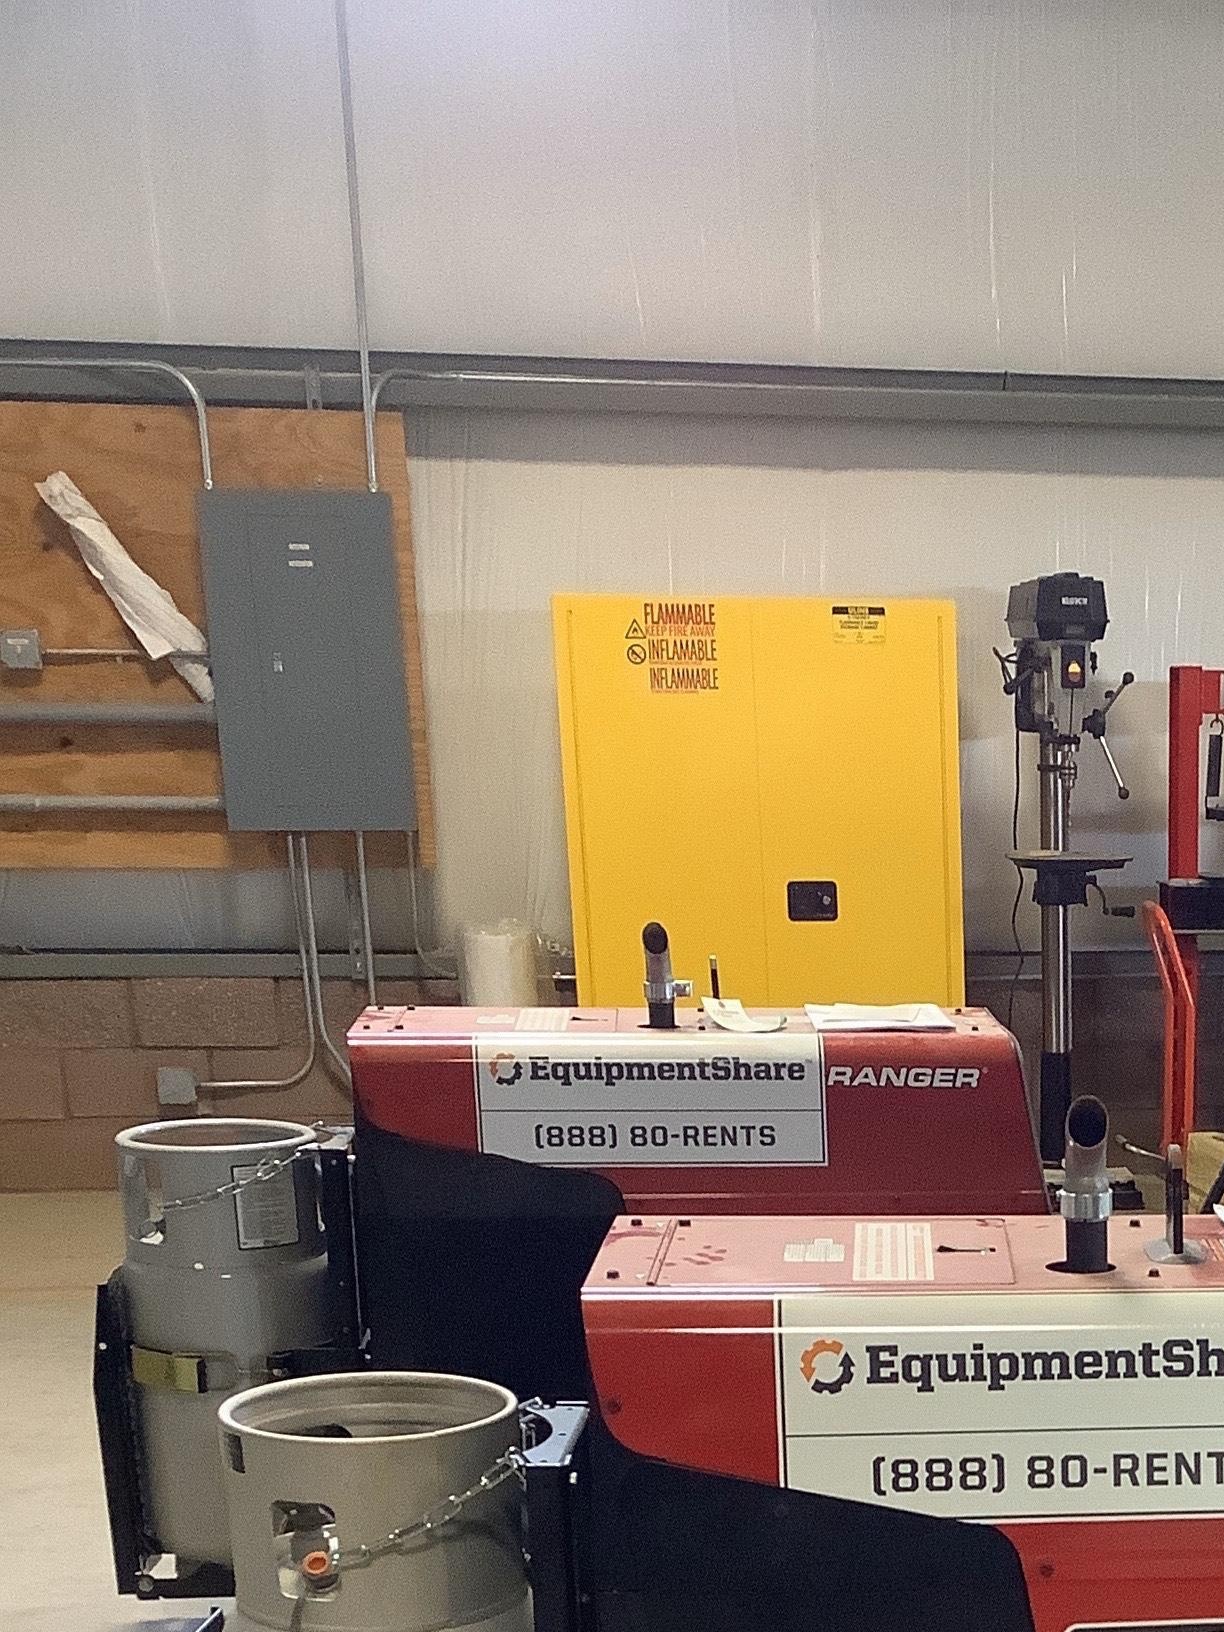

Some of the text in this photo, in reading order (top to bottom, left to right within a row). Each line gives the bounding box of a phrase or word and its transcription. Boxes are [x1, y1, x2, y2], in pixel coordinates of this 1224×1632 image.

[644, 603, 716, 625] FLAMMABLE
[645, 625, 716, 637] KEEP FIRE AWAY
[648, 638, 718, 661] INFLAMABLE
[649, 668, 719, 689] INFLAMMABLE
[528, 1055, 806, 1086] EquipmentShare
[827, 1066, 980, 1089] RANGER
[534, 1124, 777, 1149] (888) 80-RENTS
[872, 1454, 1006, 1496] (888)
